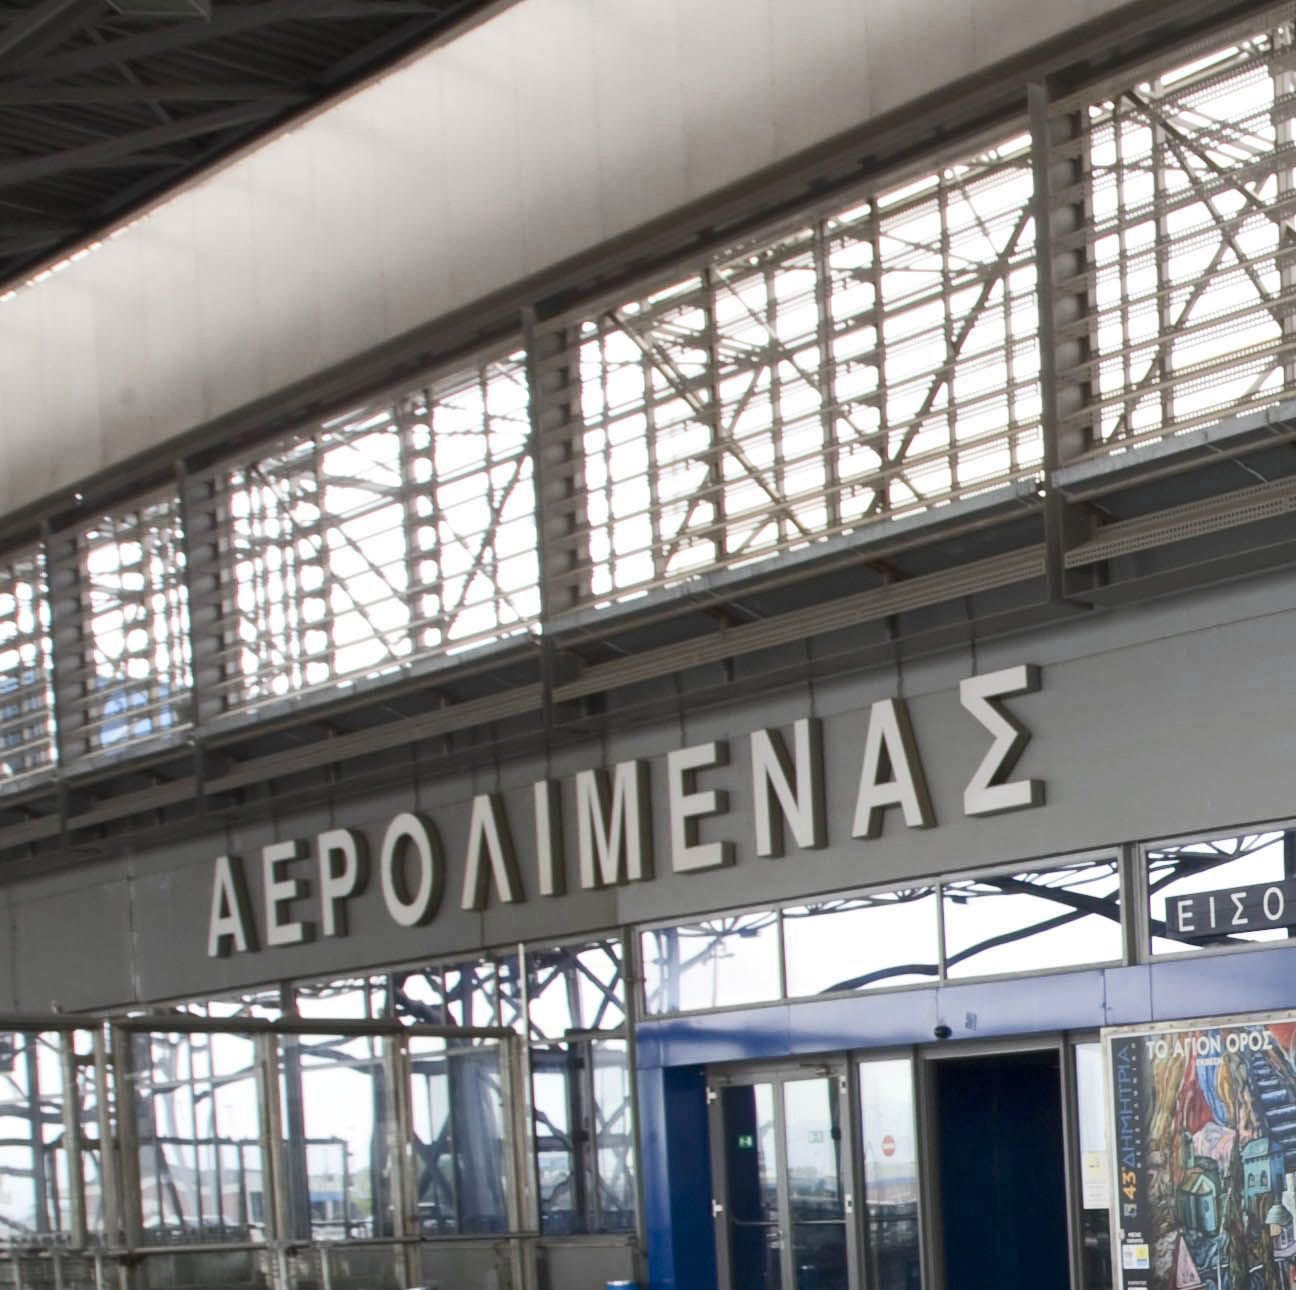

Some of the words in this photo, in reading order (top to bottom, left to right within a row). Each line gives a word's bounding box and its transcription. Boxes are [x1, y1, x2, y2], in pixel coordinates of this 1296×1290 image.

[207, 664, 1046, 958] ΑΕΡΟΛΙΜΕΝΑΣ
[1145, 1039, 1168, 1060] ΤΟ
[1172, 1035, 1221, 1057] ΑΓΙΟΝ
[1226, 1030, 1273, 1053] ΟΡΟΣ
